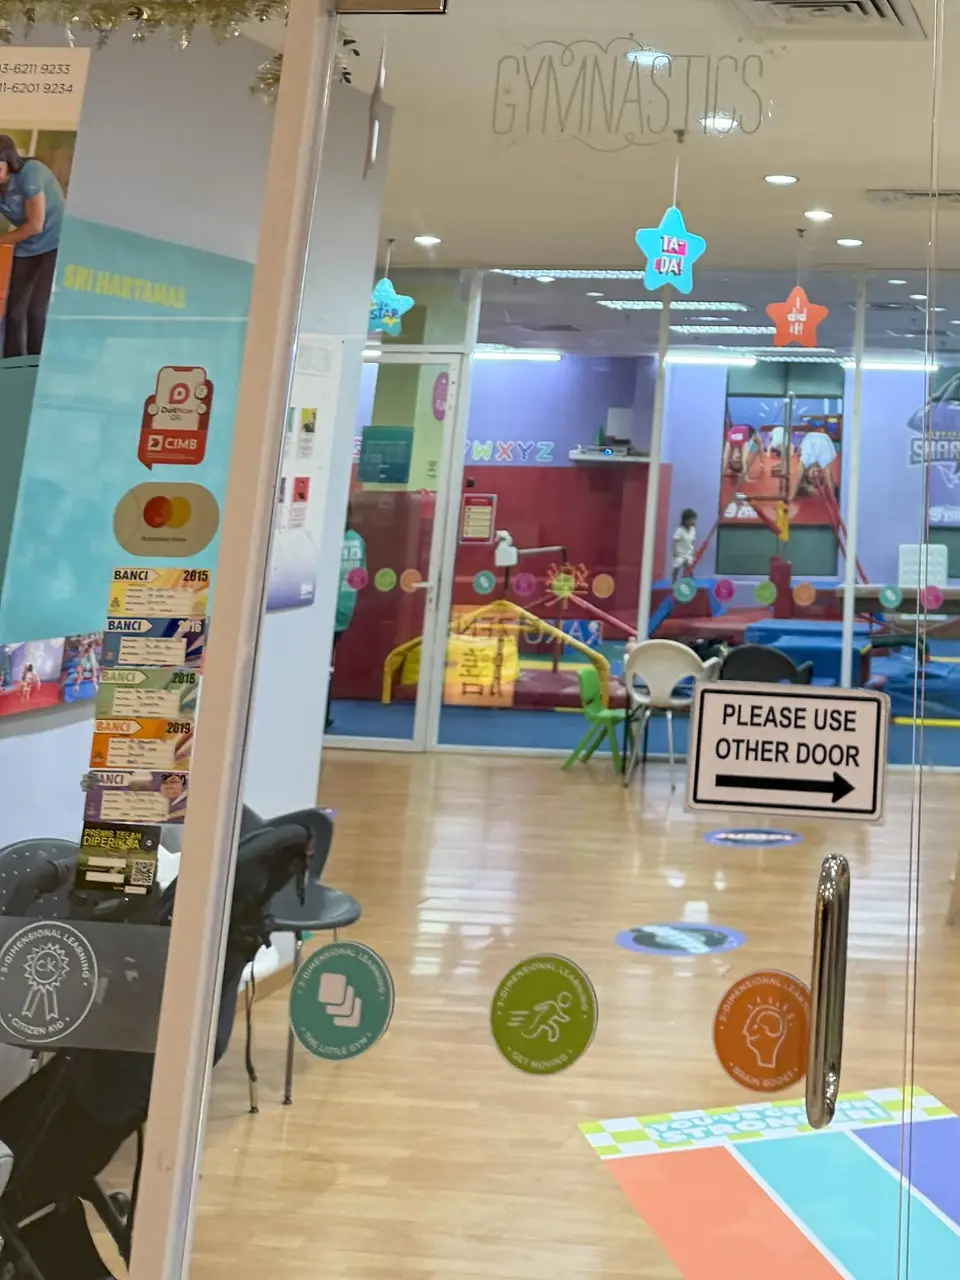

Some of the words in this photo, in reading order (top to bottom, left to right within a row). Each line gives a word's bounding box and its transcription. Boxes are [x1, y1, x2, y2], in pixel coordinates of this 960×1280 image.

[0, 63, 37, 75] 3-6211
[40, 63, 71, 75] 9233
[43, 82, 73, 94] 9234
[492, 54, 764, 135] GYMNASTICS
[164, 437, 198, 451] CIMB
[113, 570, 149, 581] BANCI
[183, 570, 209, 582] 2015
[107, 620, 142, 631] BANCI
[102, 671, 136, 682] BANCI
[722, 703, 807, 729] PLEASE
[814, 708, 857, 732] USE
[96, 721, 130, 732] BANCI
[166, 721, 191, 734] 2019
[715, 737, 789, 763] OTHER
[796, 742, 860, 767] DOOR
[99, 773, 125, 785] ANCI
[82, 835, 140, 849] DIPERIKSA
[62, 933, 91, 979] LEARNING
[11, 1017, 46, 1035] CITIZEN
[47, 1020, 64, 1033] KID
